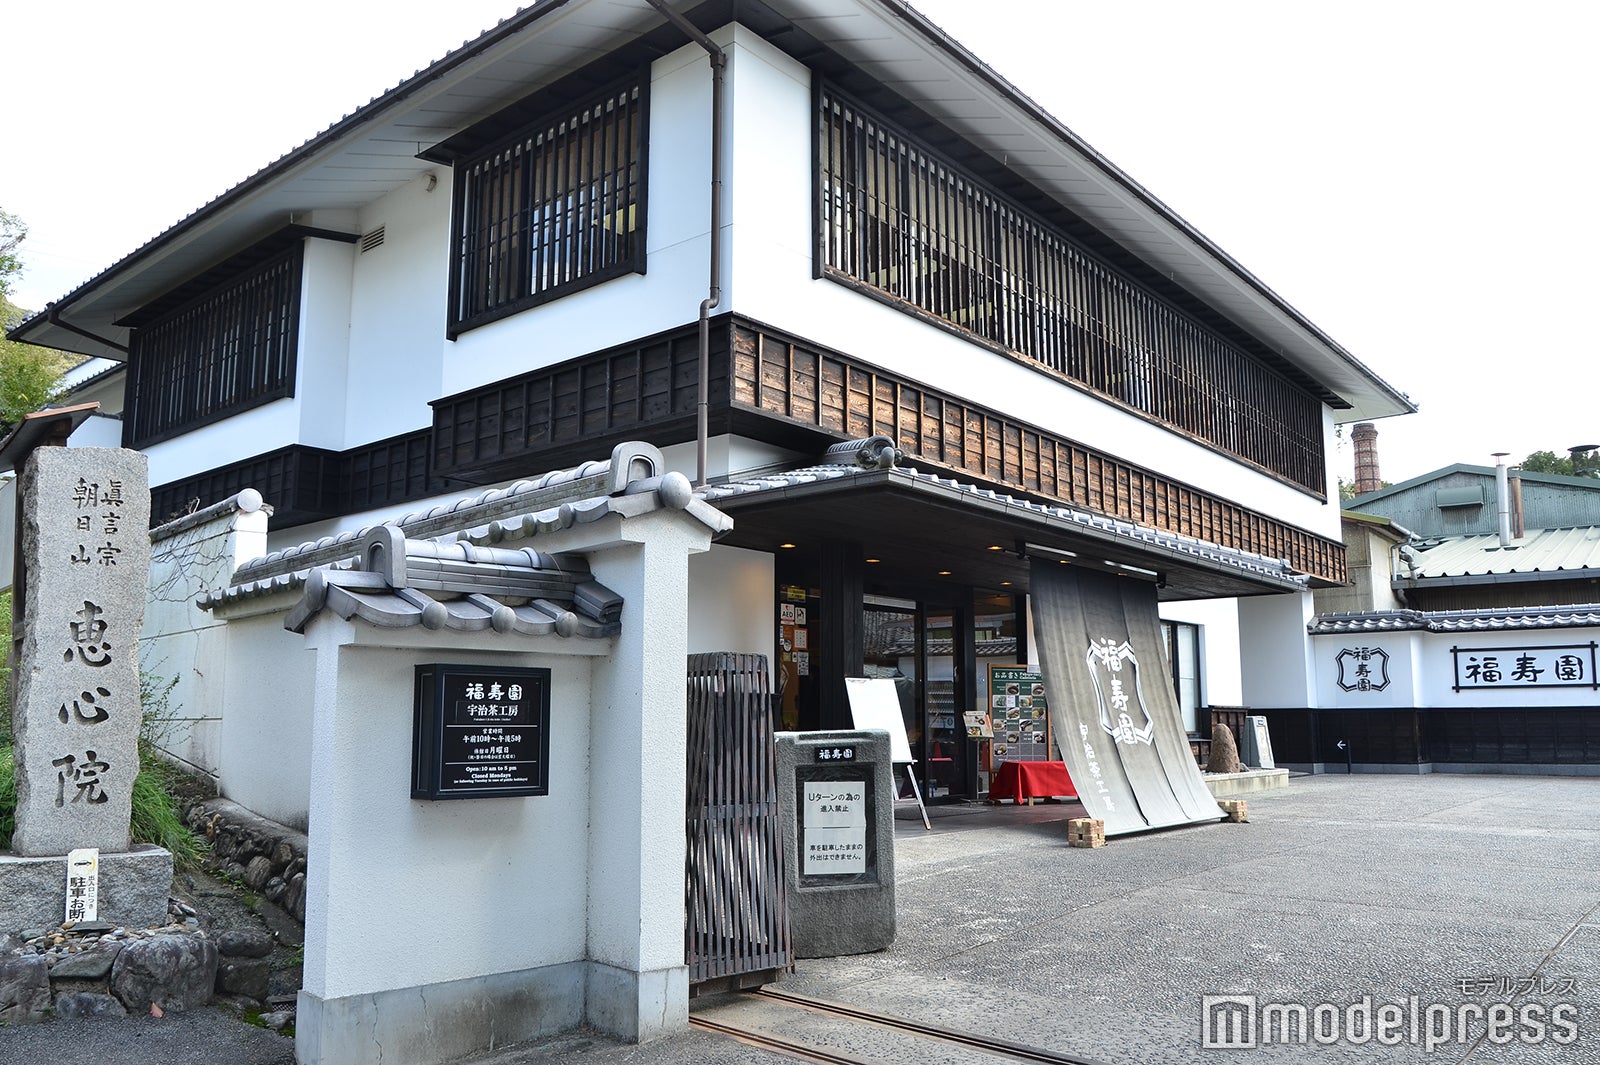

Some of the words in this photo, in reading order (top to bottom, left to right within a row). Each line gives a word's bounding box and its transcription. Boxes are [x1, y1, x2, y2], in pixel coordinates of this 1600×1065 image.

[70, 476, 99, 566] 朝日山
[782, 610, 794, 618] AED
[1353, 646, 1372, 692] 福寿園
[1465, 652, 1584, 683] 福寿園
[466, 682, 523, 701] 福寿園
[1100, 637, 1138, 745] 福寿園
[52, 600, 112, 808] 恵心院
[467, 704, 518, 716] 宇治茶工房
[818, 748, 853, 760] 福寿園
[808, 793, 861, 802] Uターンの為の
[820, 805, 849, 813] 進入禁止
[809, 844, 864, 852] 車を駐車したままの
[68, 876, 87, 922] 駐車お断
[87, 875, 95, 909] 出入口につき
